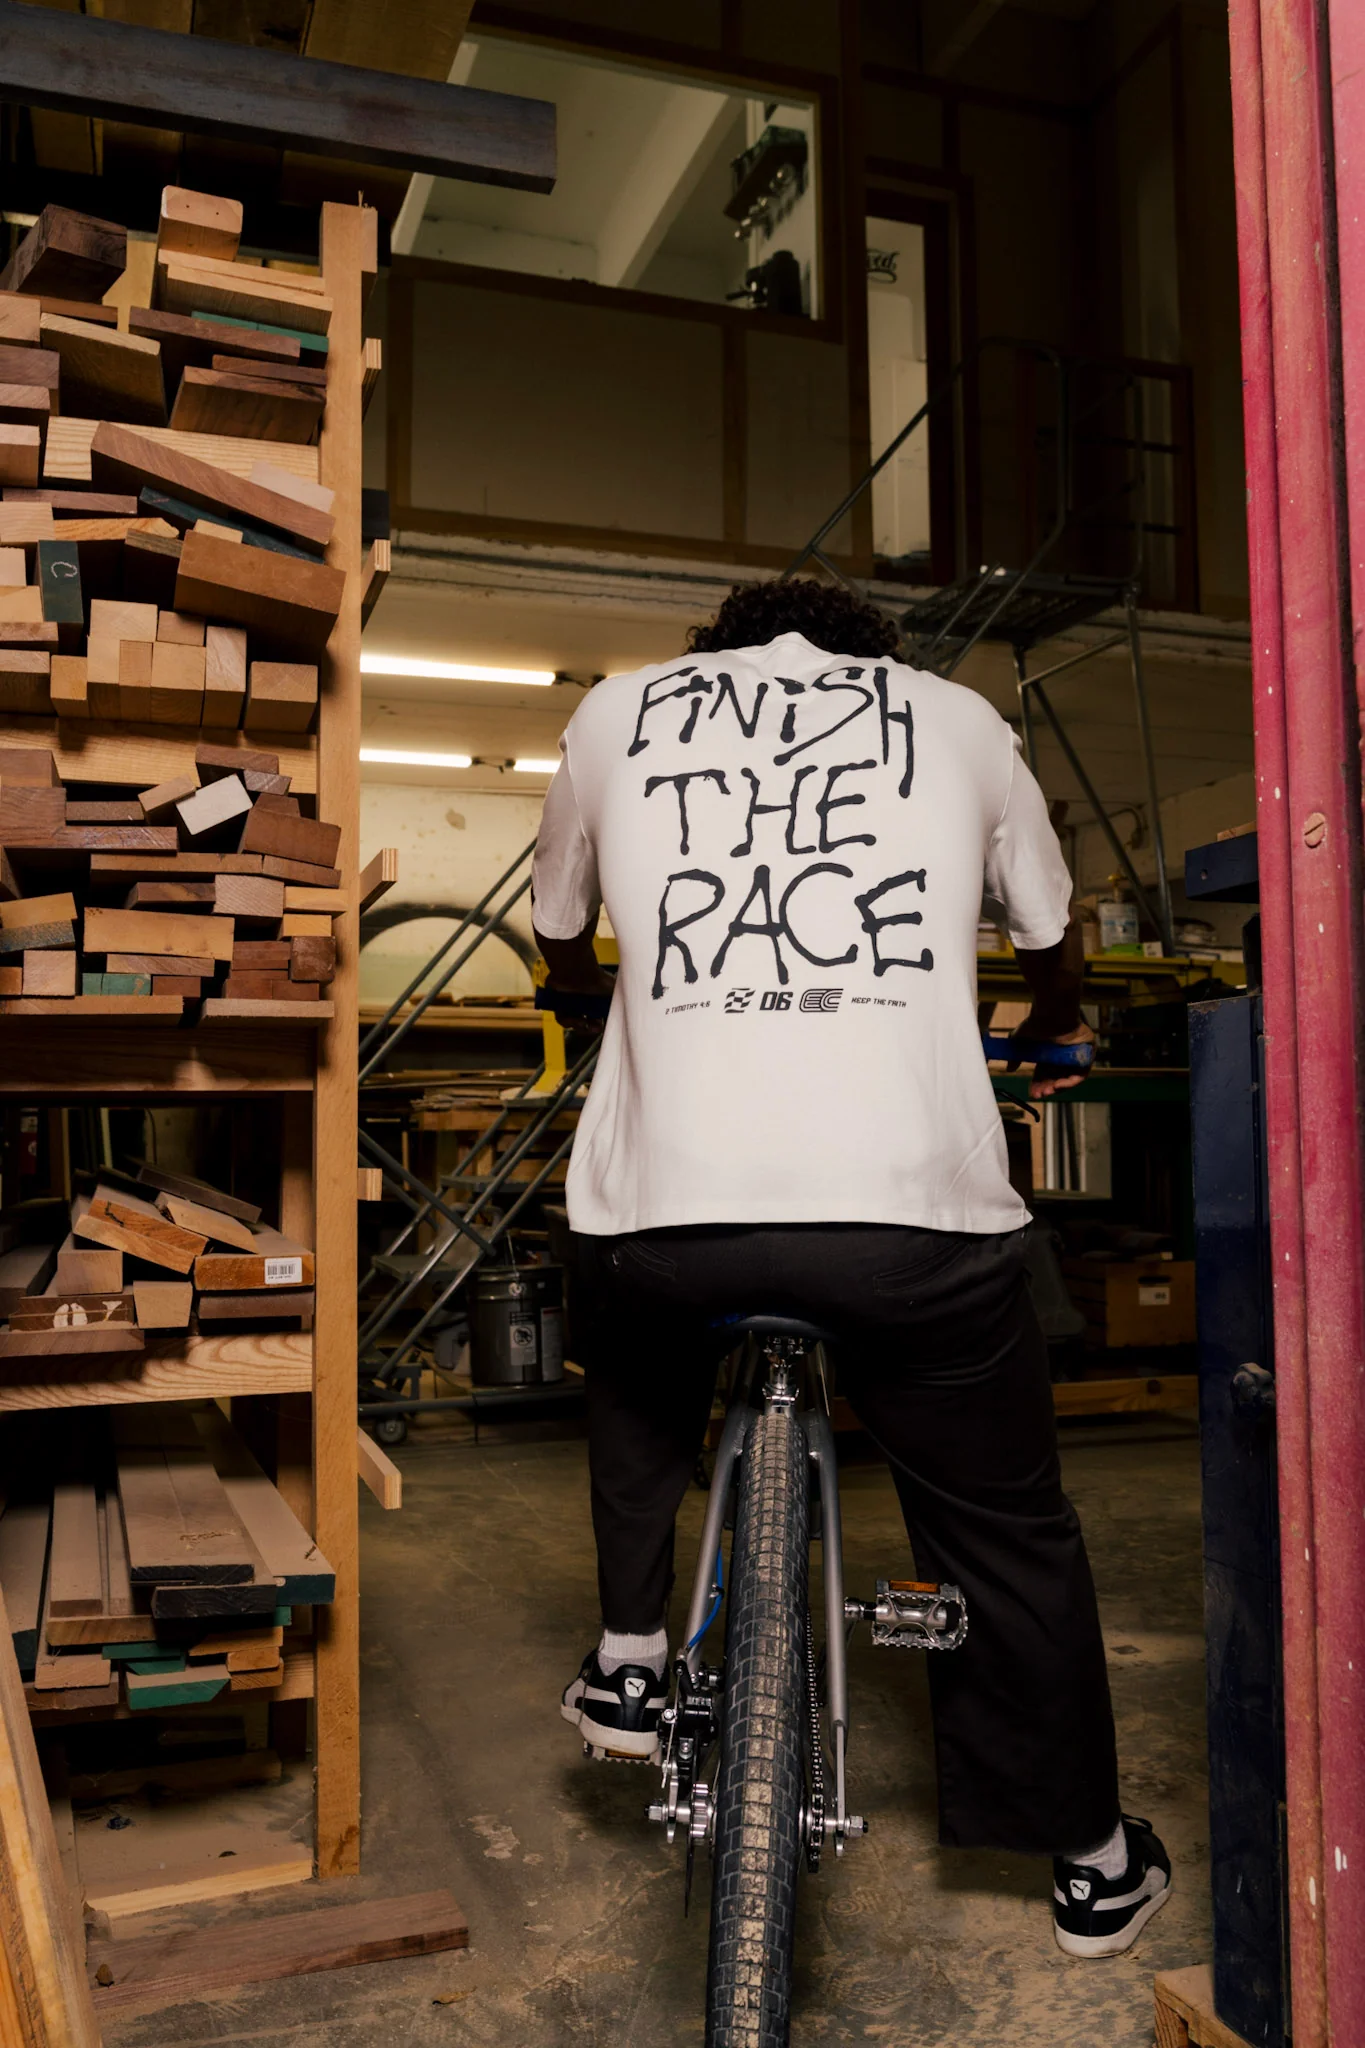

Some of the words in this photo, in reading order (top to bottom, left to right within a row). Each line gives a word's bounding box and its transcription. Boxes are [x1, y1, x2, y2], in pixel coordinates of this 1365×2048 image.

[644, 759, 878, 858] THE
[651, 862, 934, 1000] RACE
[671, 1003, 698, 1014] TIMOTHY
[759, 991, 793, 1011] 06
[851, 997, 872, 1005] KEEP
[873, 998, 888, 1007] THE
[888, 999, 908, 1009] FAITH
